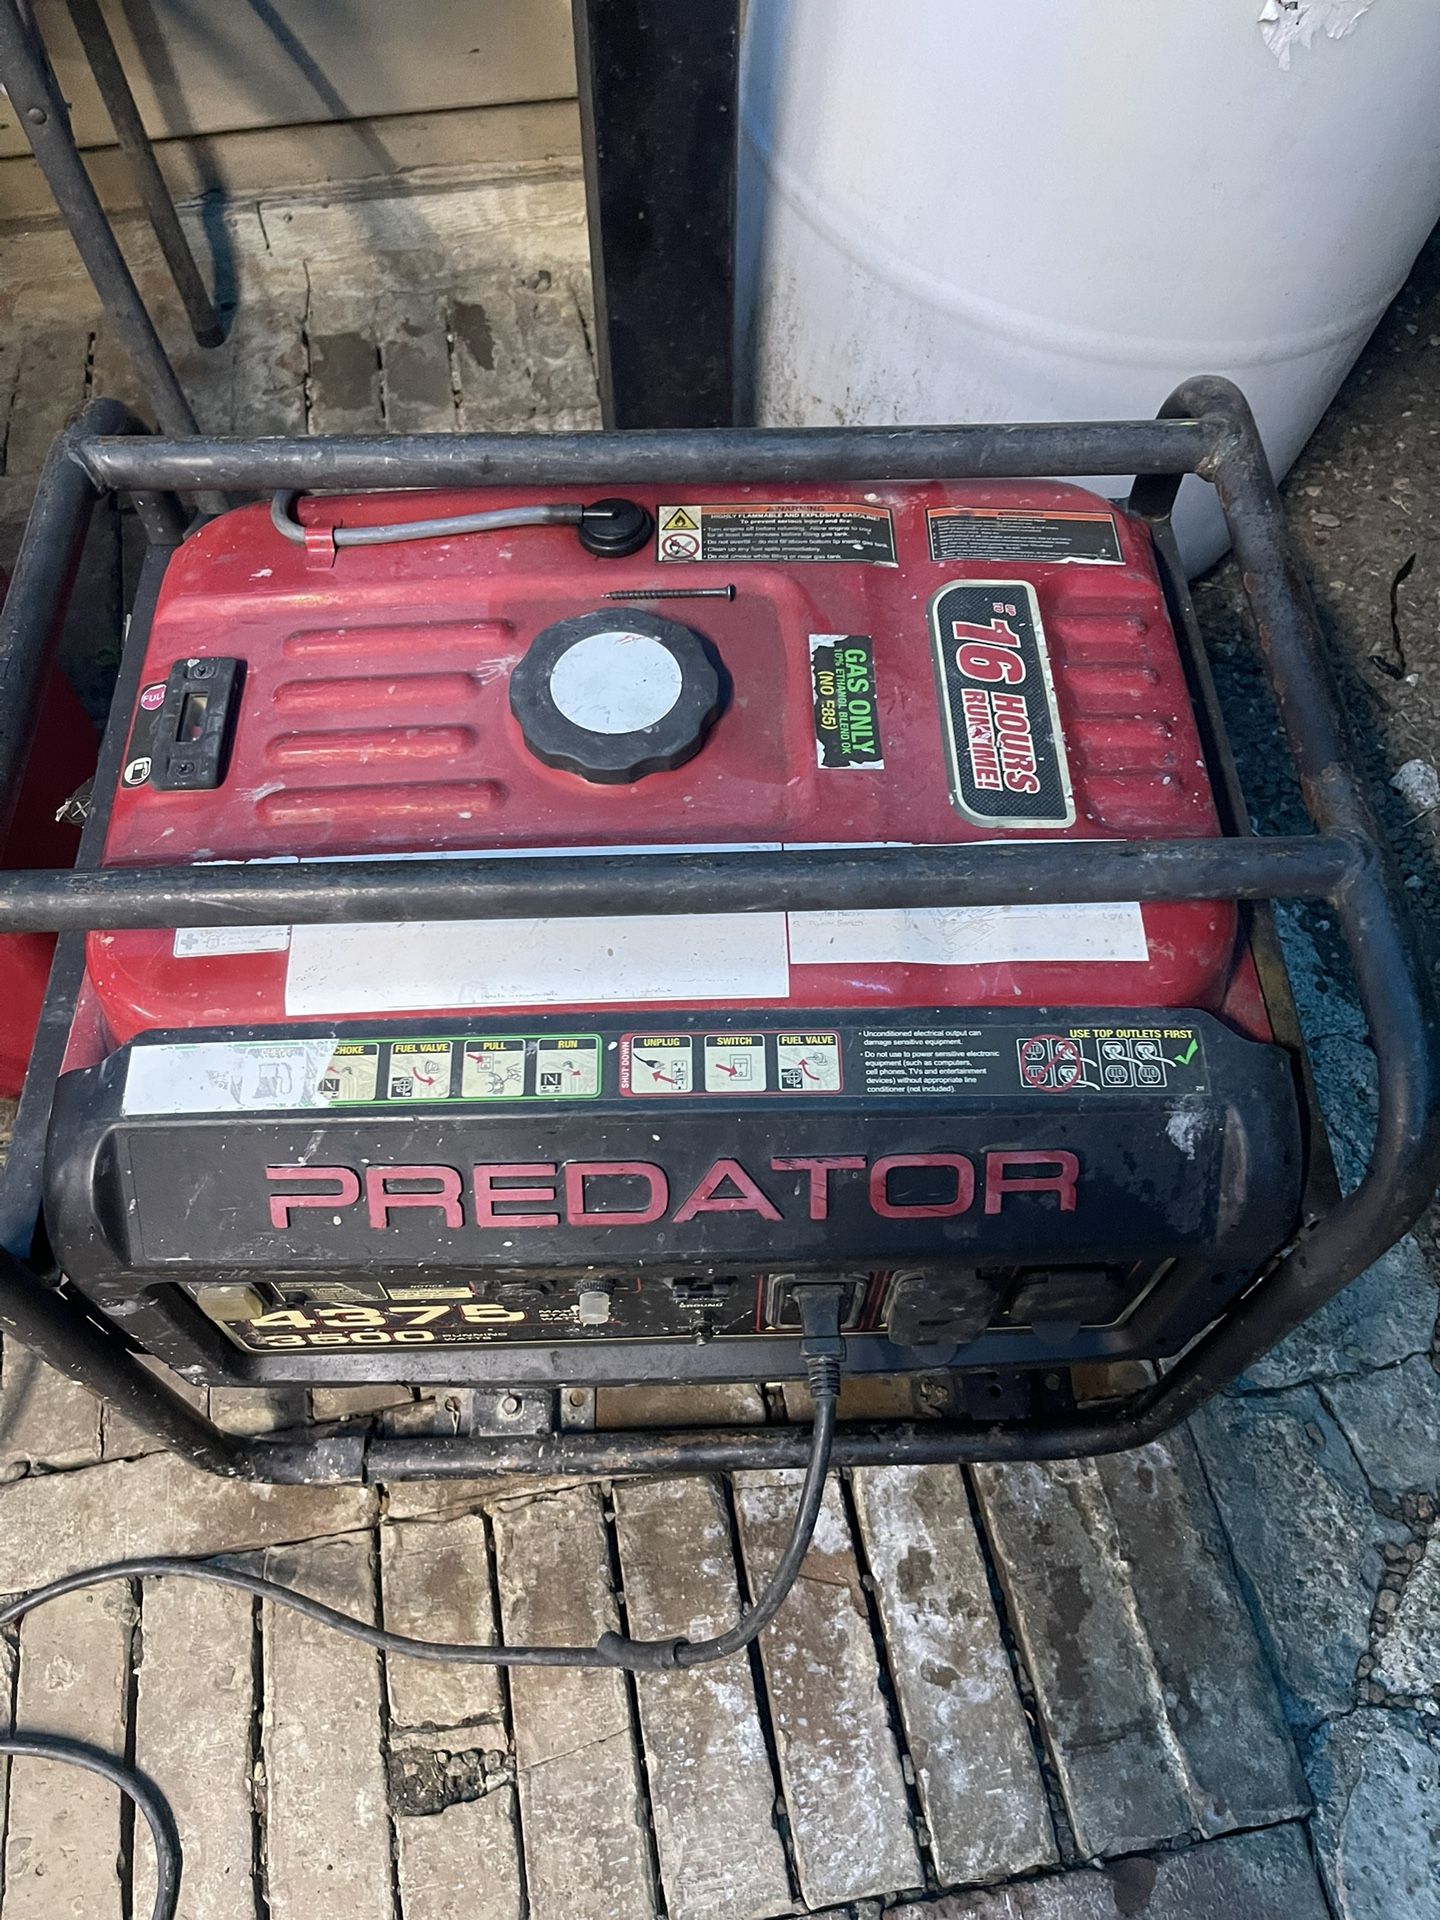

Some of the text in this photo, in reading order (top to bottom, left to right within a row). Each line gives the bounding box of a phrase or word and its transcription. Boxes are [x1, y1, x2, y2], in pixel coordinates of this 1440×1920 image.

[992, 602, 1004, 614] TO
[1005, 604, 1016, 616] UP
[951, 618, 1026, 685] 16
[817, 671, 835, 695] (NO
[834, 648, 852, 754] 10% ETHANOL BLEND OK
[844, 649, 876, 754] GAS ONLY
[991, 691, 1041, 794] HOURS
[781, 1036, 834, 1045] FUEL VALVE
[1069, 1029, 1193, 1038] USE TOP OUTLETS FIRST
[395, 1043, 449, 1053] FUEL VALVE
[483, 1042, 506, 1050] PULL
[558, 1040, 578, 1048] RUN
[643, 1038, 680, 1047] UNPLUG
[717, 1037, 752, 1045] SWITCH
[621, 1041, 630, 1088] SHUT DOWN
[266, 1151, 1080, 1229] PREDATOR
[250, 1304, 525, 1328] 4375
[265, 1331, 435, 1347] 3500
